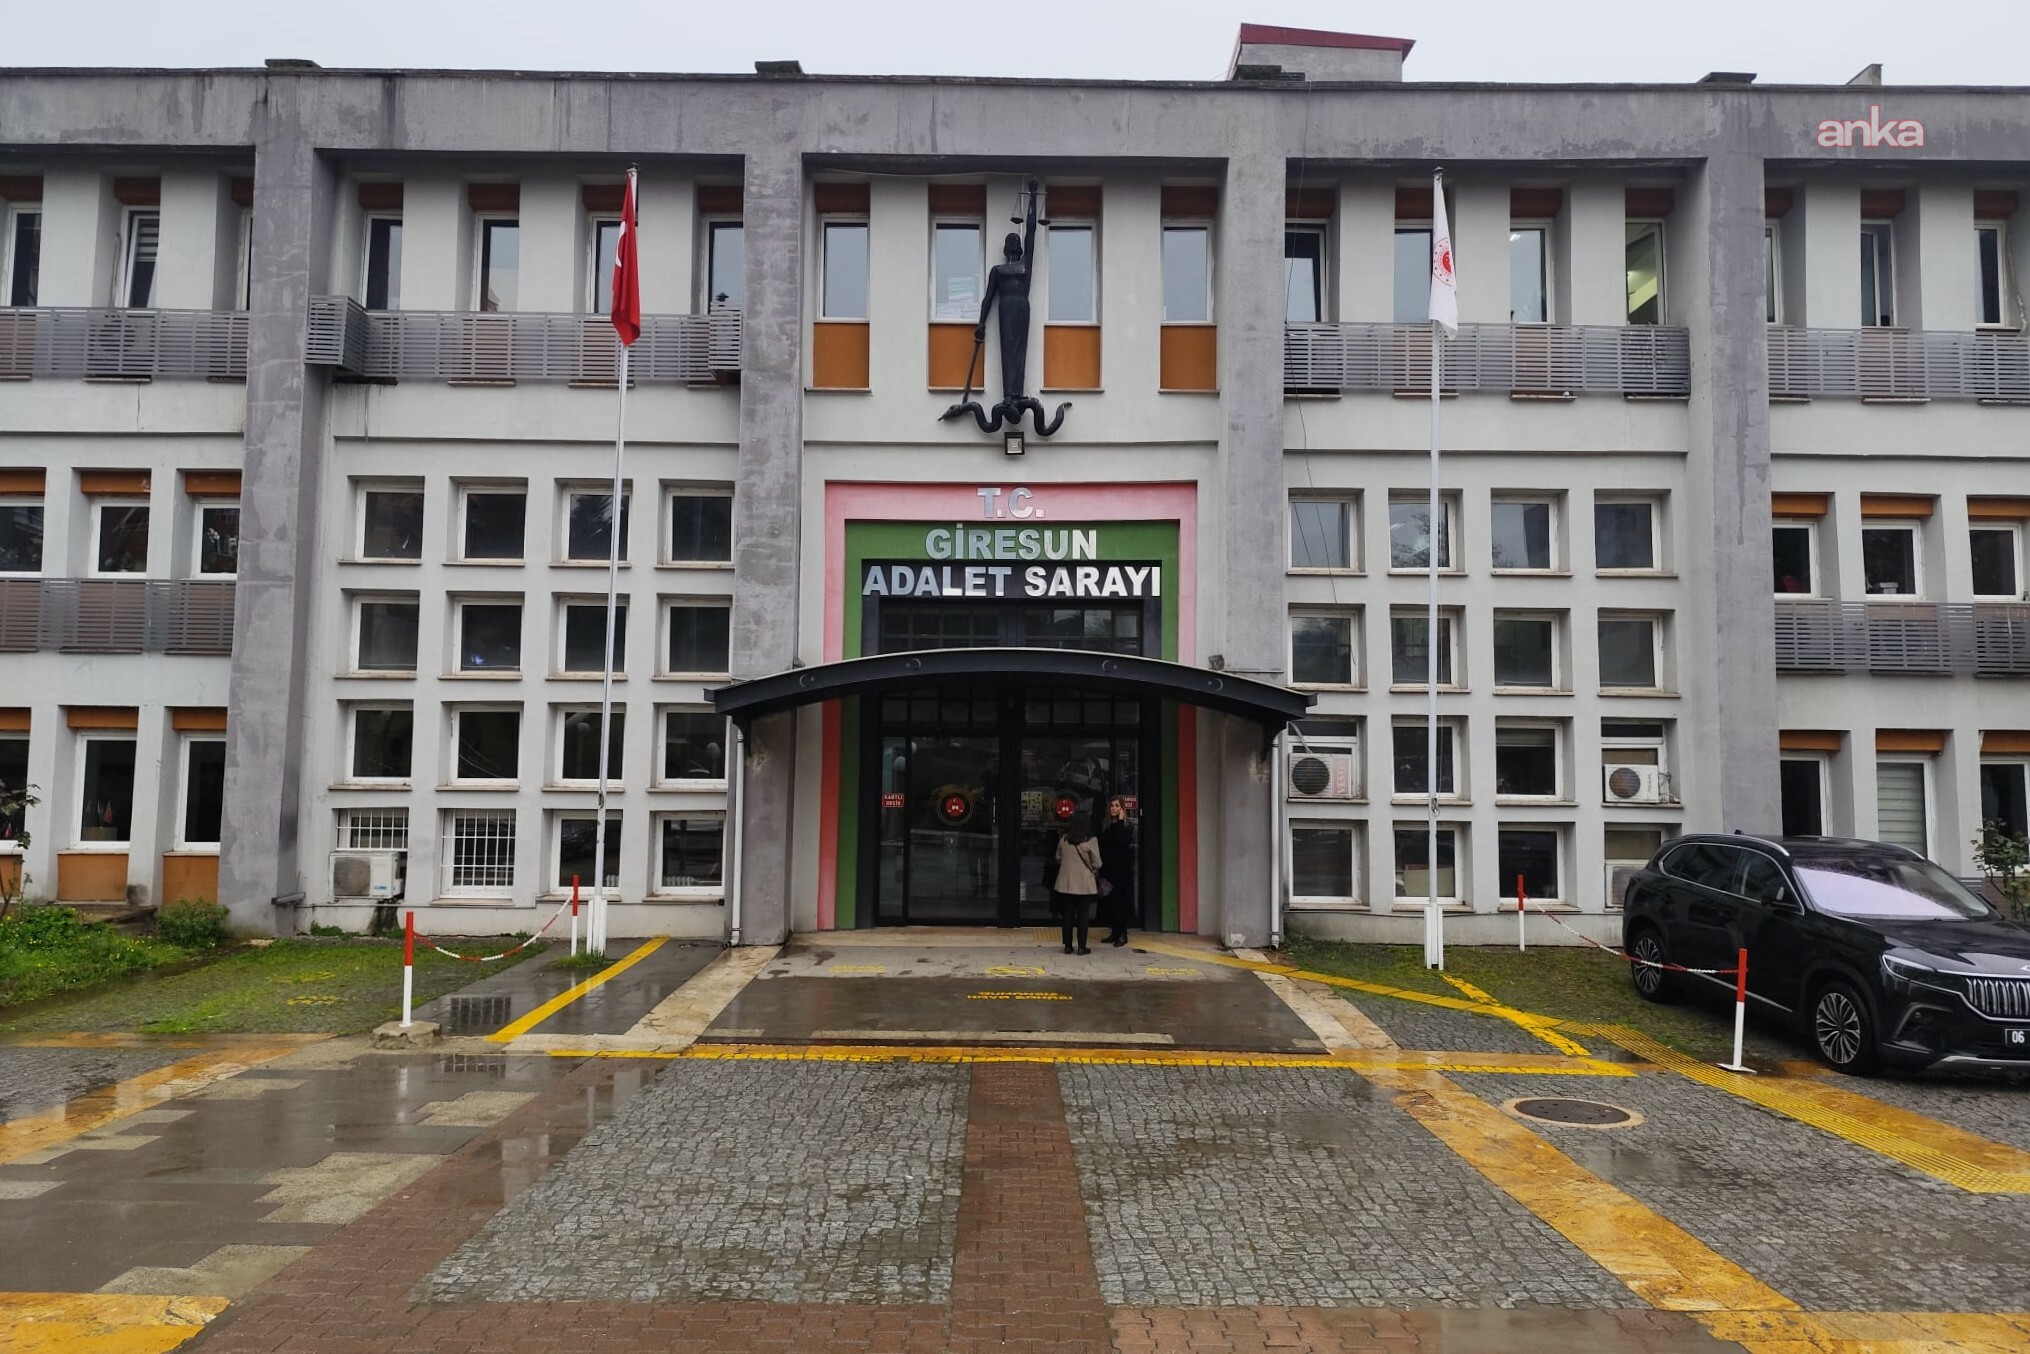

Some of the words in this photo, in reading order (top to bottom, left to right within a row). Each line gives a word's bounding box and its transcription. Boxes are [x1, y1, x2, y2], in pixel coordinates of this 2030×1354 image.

[977, 487, 1046, 519] T.C.
[925, 523, 1097, 561] GİRESUN
[861, 565, 1012, 597] ADALET
[1024, 566, 1161, 597] SARAYI
[2012, 1030, 2025, 1043] 06
